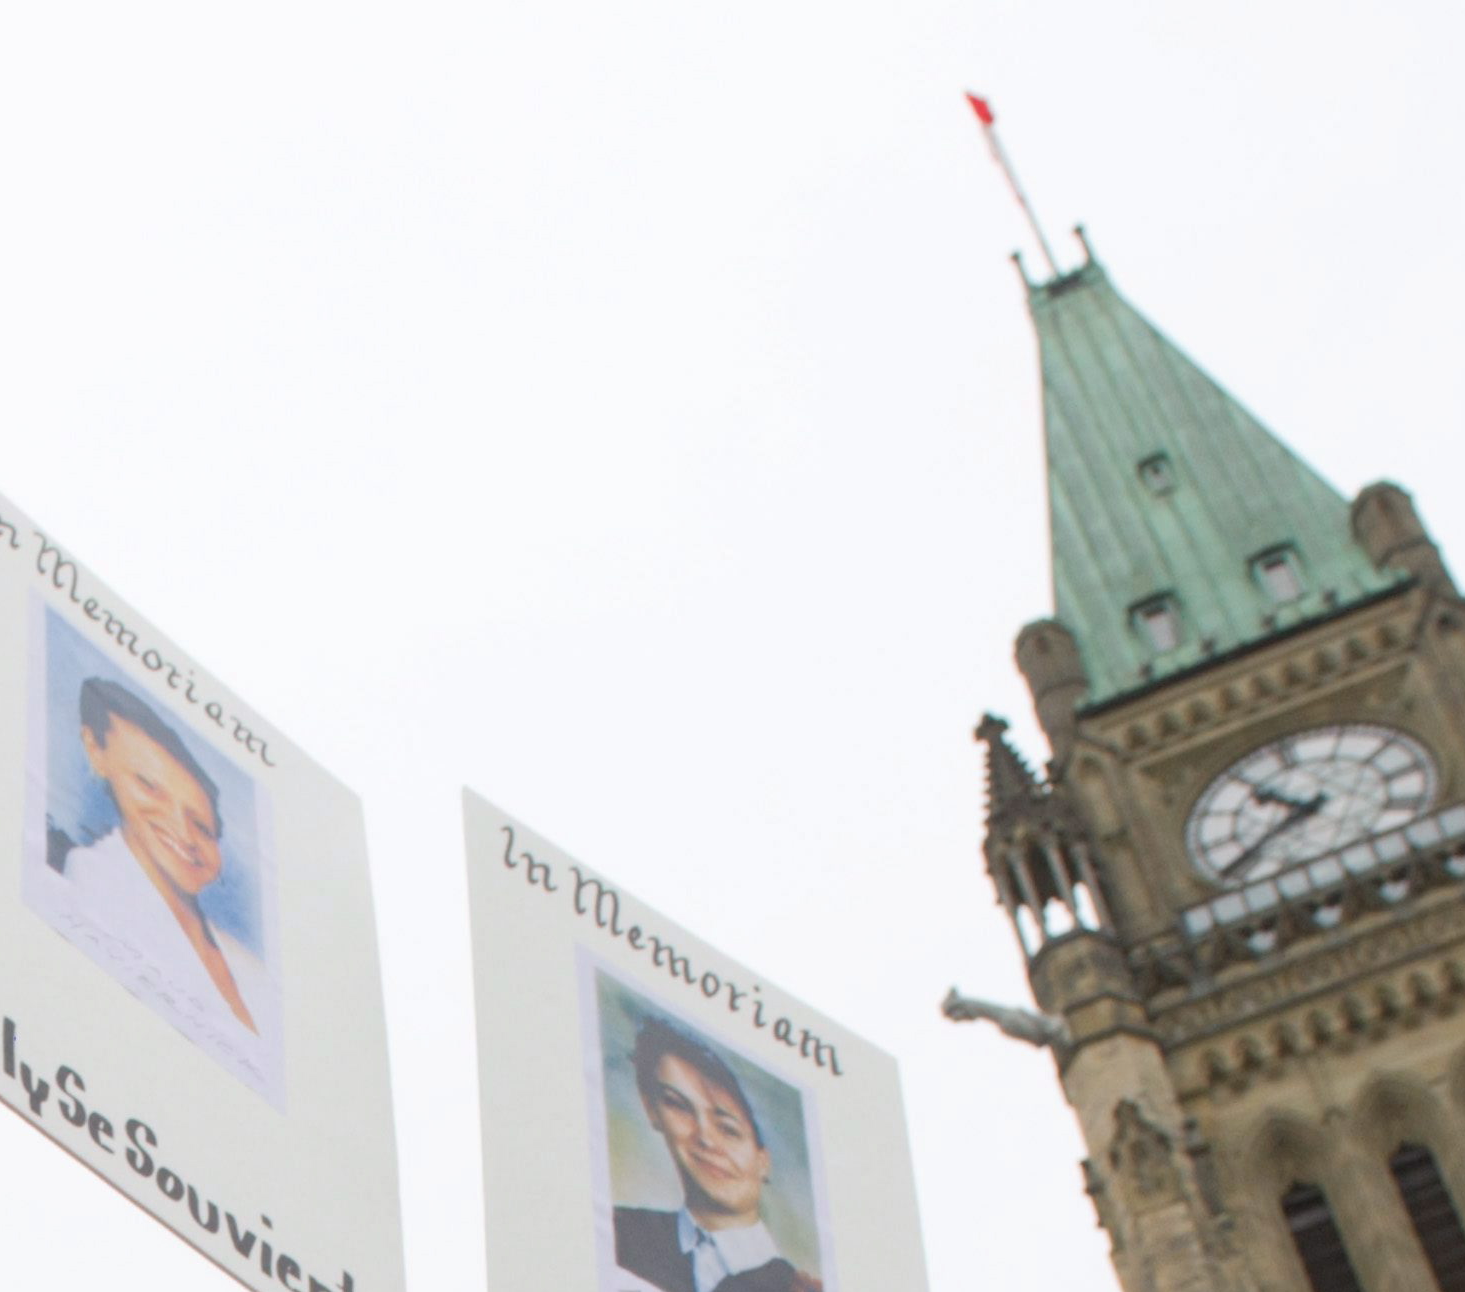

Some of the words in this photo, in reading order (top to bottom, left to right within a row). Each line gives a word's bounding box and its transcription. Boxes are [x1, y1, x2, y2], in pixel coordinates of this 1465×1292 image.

[34, 531, 276, 767] Memoriam
[501, 826, 557, 891] In
[569, 866, 843, 1076] Memoriam
